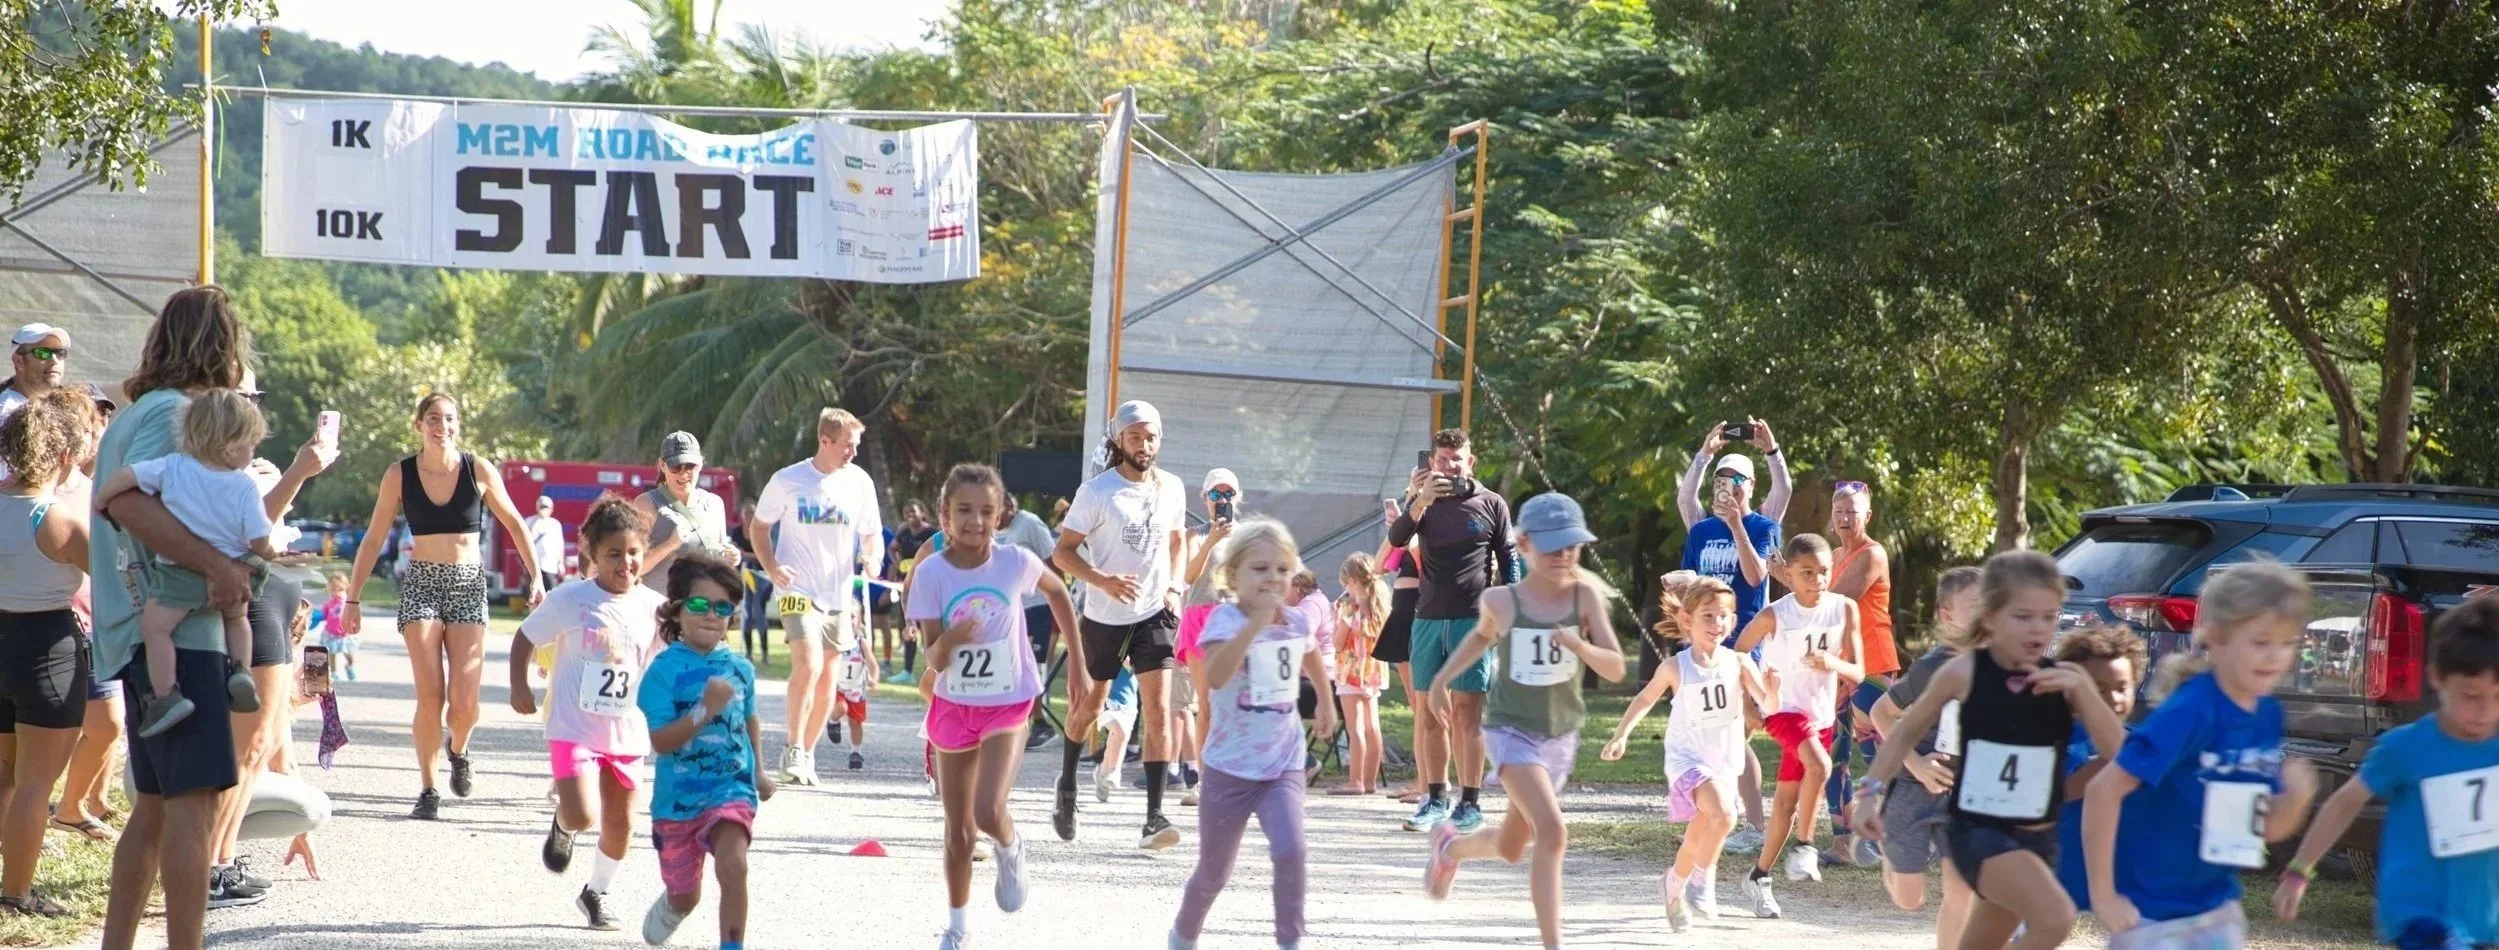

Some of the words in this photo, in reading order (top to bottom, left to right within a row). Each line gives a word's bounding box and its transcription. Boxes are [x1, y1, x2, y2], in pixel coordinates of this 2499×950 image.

[332, 119, 371, 149] 1K
[456, 123, 559, 158] M2M
[578, 128, 687, 161] ROAD
[875, 185, 895, 195] ACE
[316, 208, 383, 240] 10K
[455, 166, 815, 259] START
[780, 596, 806, 612] 205
[1531, 634, 1562, 665] 18
[1804, 632, 1828, 657] 14
[846, 664, 853, 680] 1
[959, 649, 994, 678] 22
[1278, 646, 1291, 680] 8
[598, 668, 629, 698] 23
[1700, 683, 1727, 712] 10
[1999, 753, 2020, 791] 4
[2465, 777, 2487, 822] 7
